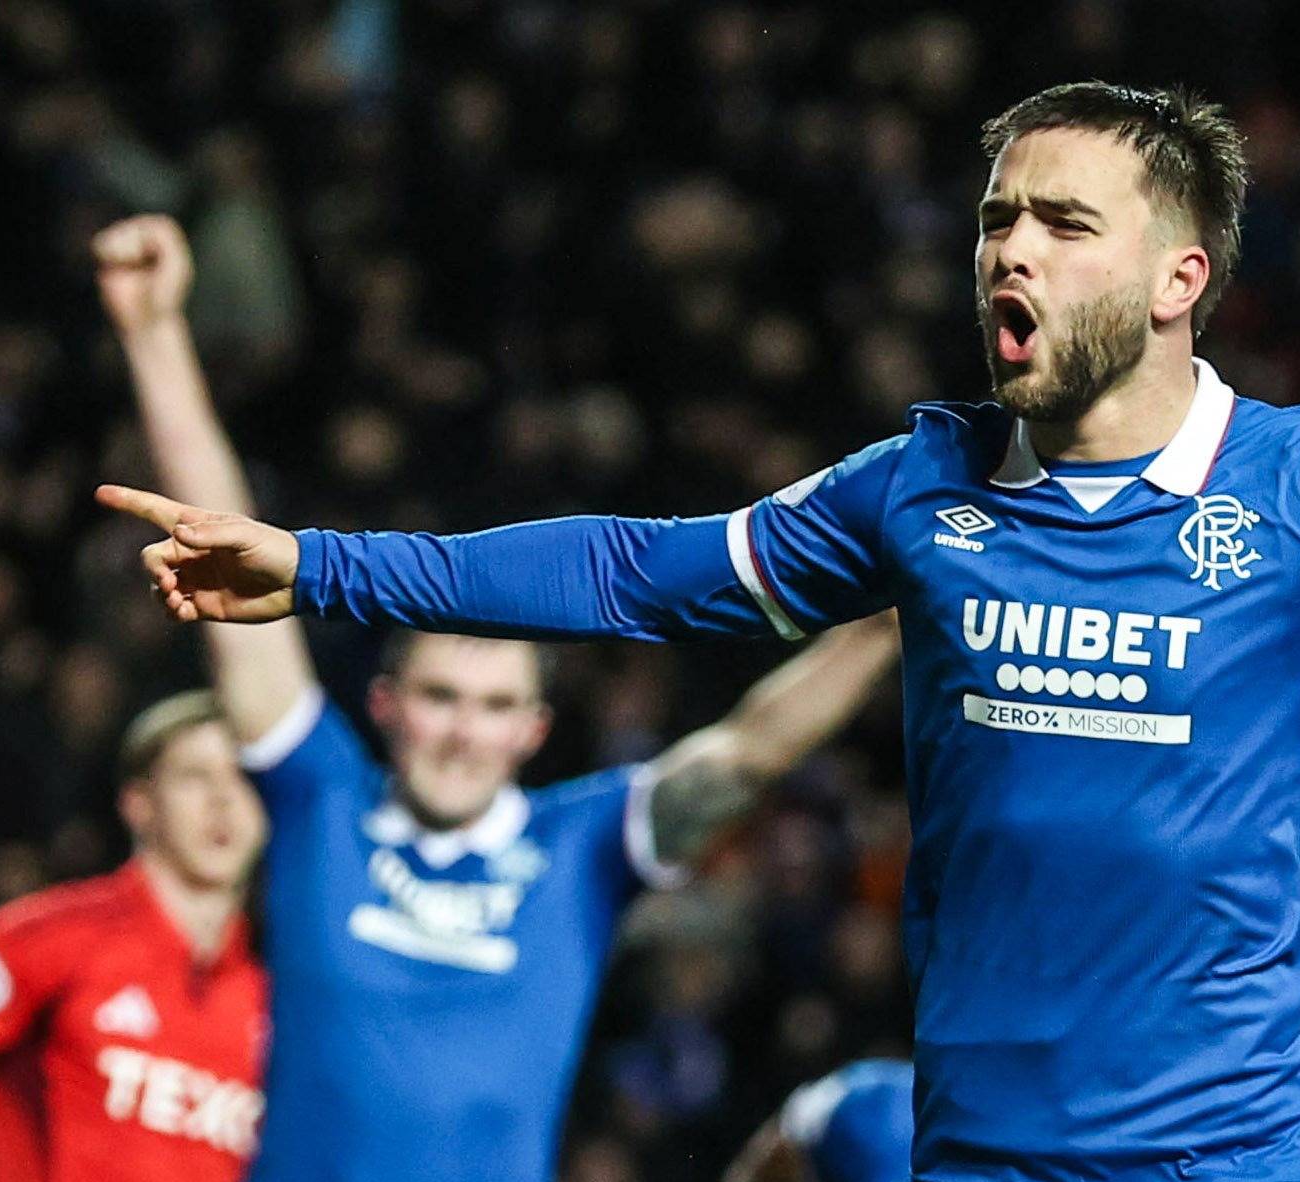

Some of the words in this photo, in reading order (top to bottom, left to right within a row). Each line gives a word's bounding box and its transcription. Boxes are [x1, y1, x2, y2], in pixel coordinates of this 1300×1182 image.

[933, 532, 985, 553] umbro
[962, 598, 1202, 670] UNIBET
[1068, 712, 1158, 737] MISSION
